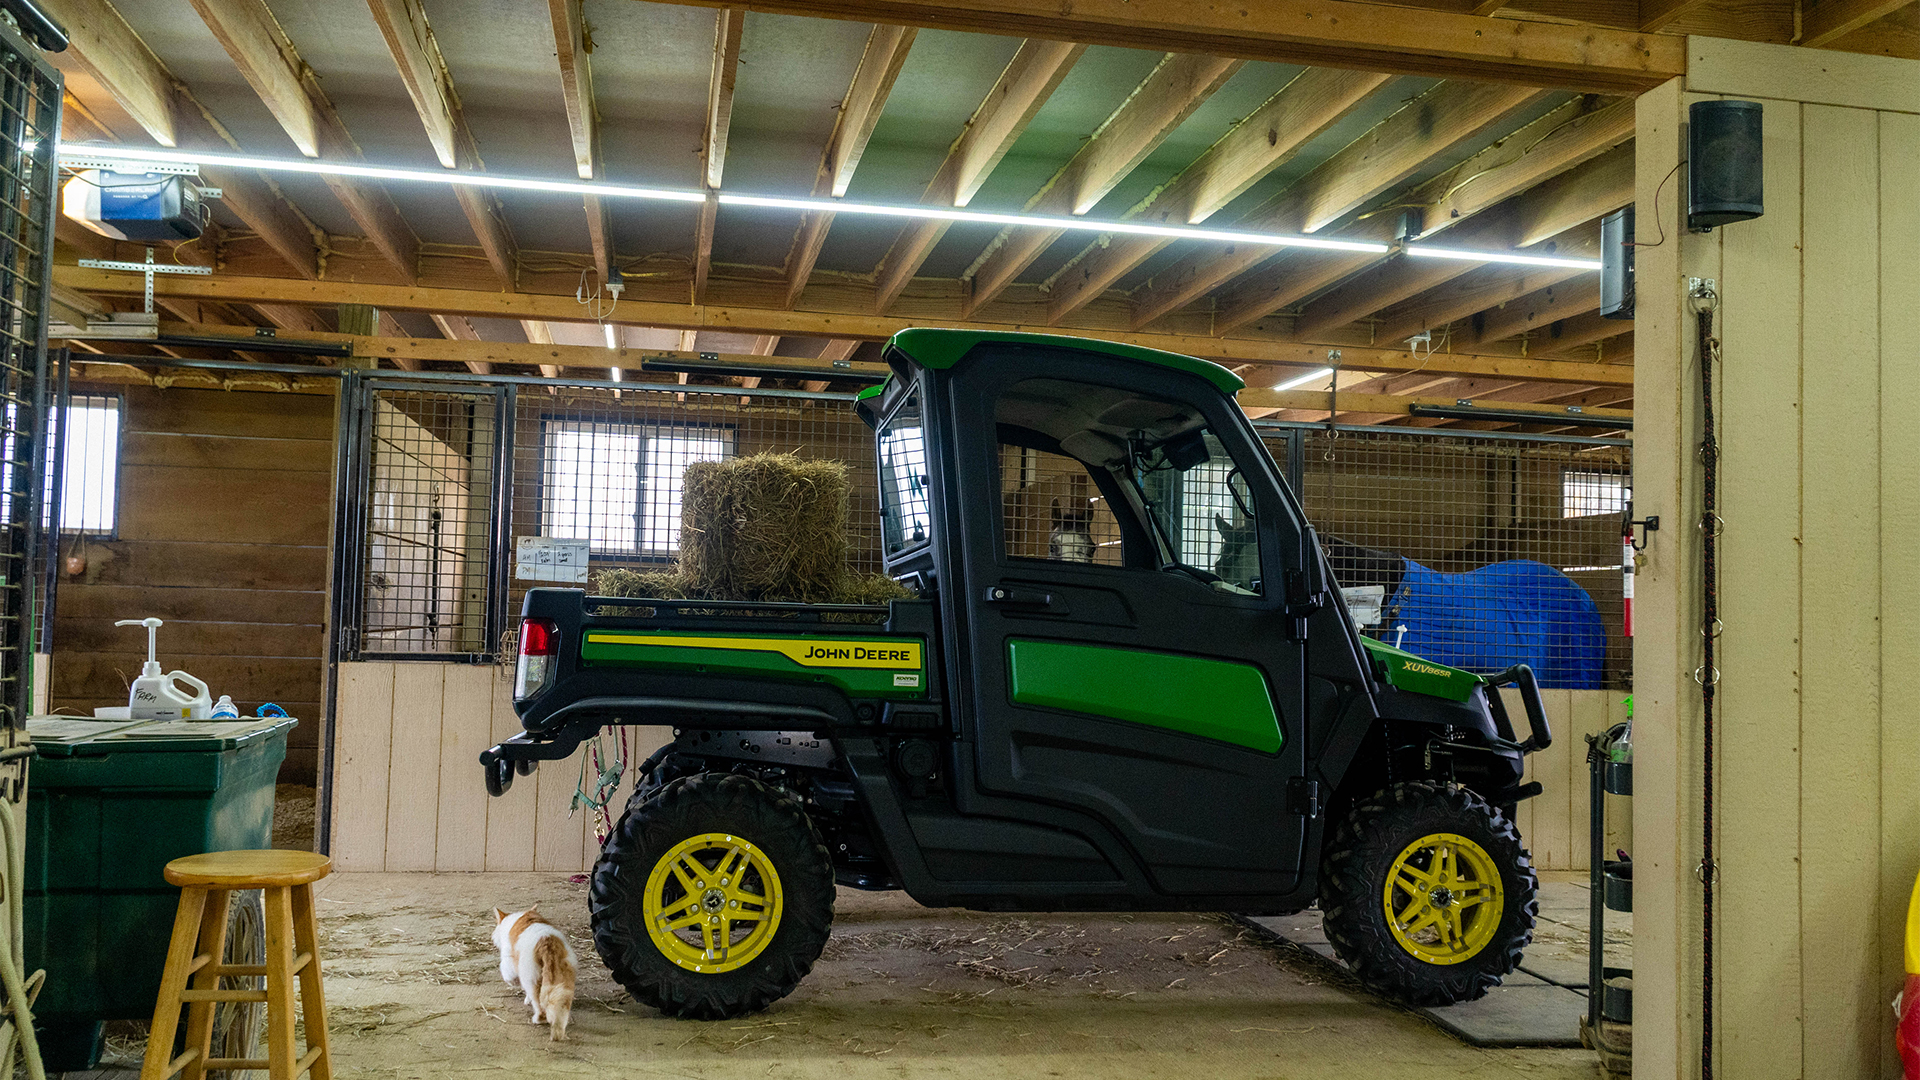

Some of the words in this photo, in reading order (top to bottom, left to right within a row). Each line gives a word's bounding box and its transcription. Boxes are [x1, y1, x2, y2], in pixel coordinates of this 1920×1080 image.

[804, 646, 850, 659] JOHN
[854, 647, 910, 661] DEERE
[1402, 660, 1452, 678] XUV865R
[134, 688, 157, 703] FARM
